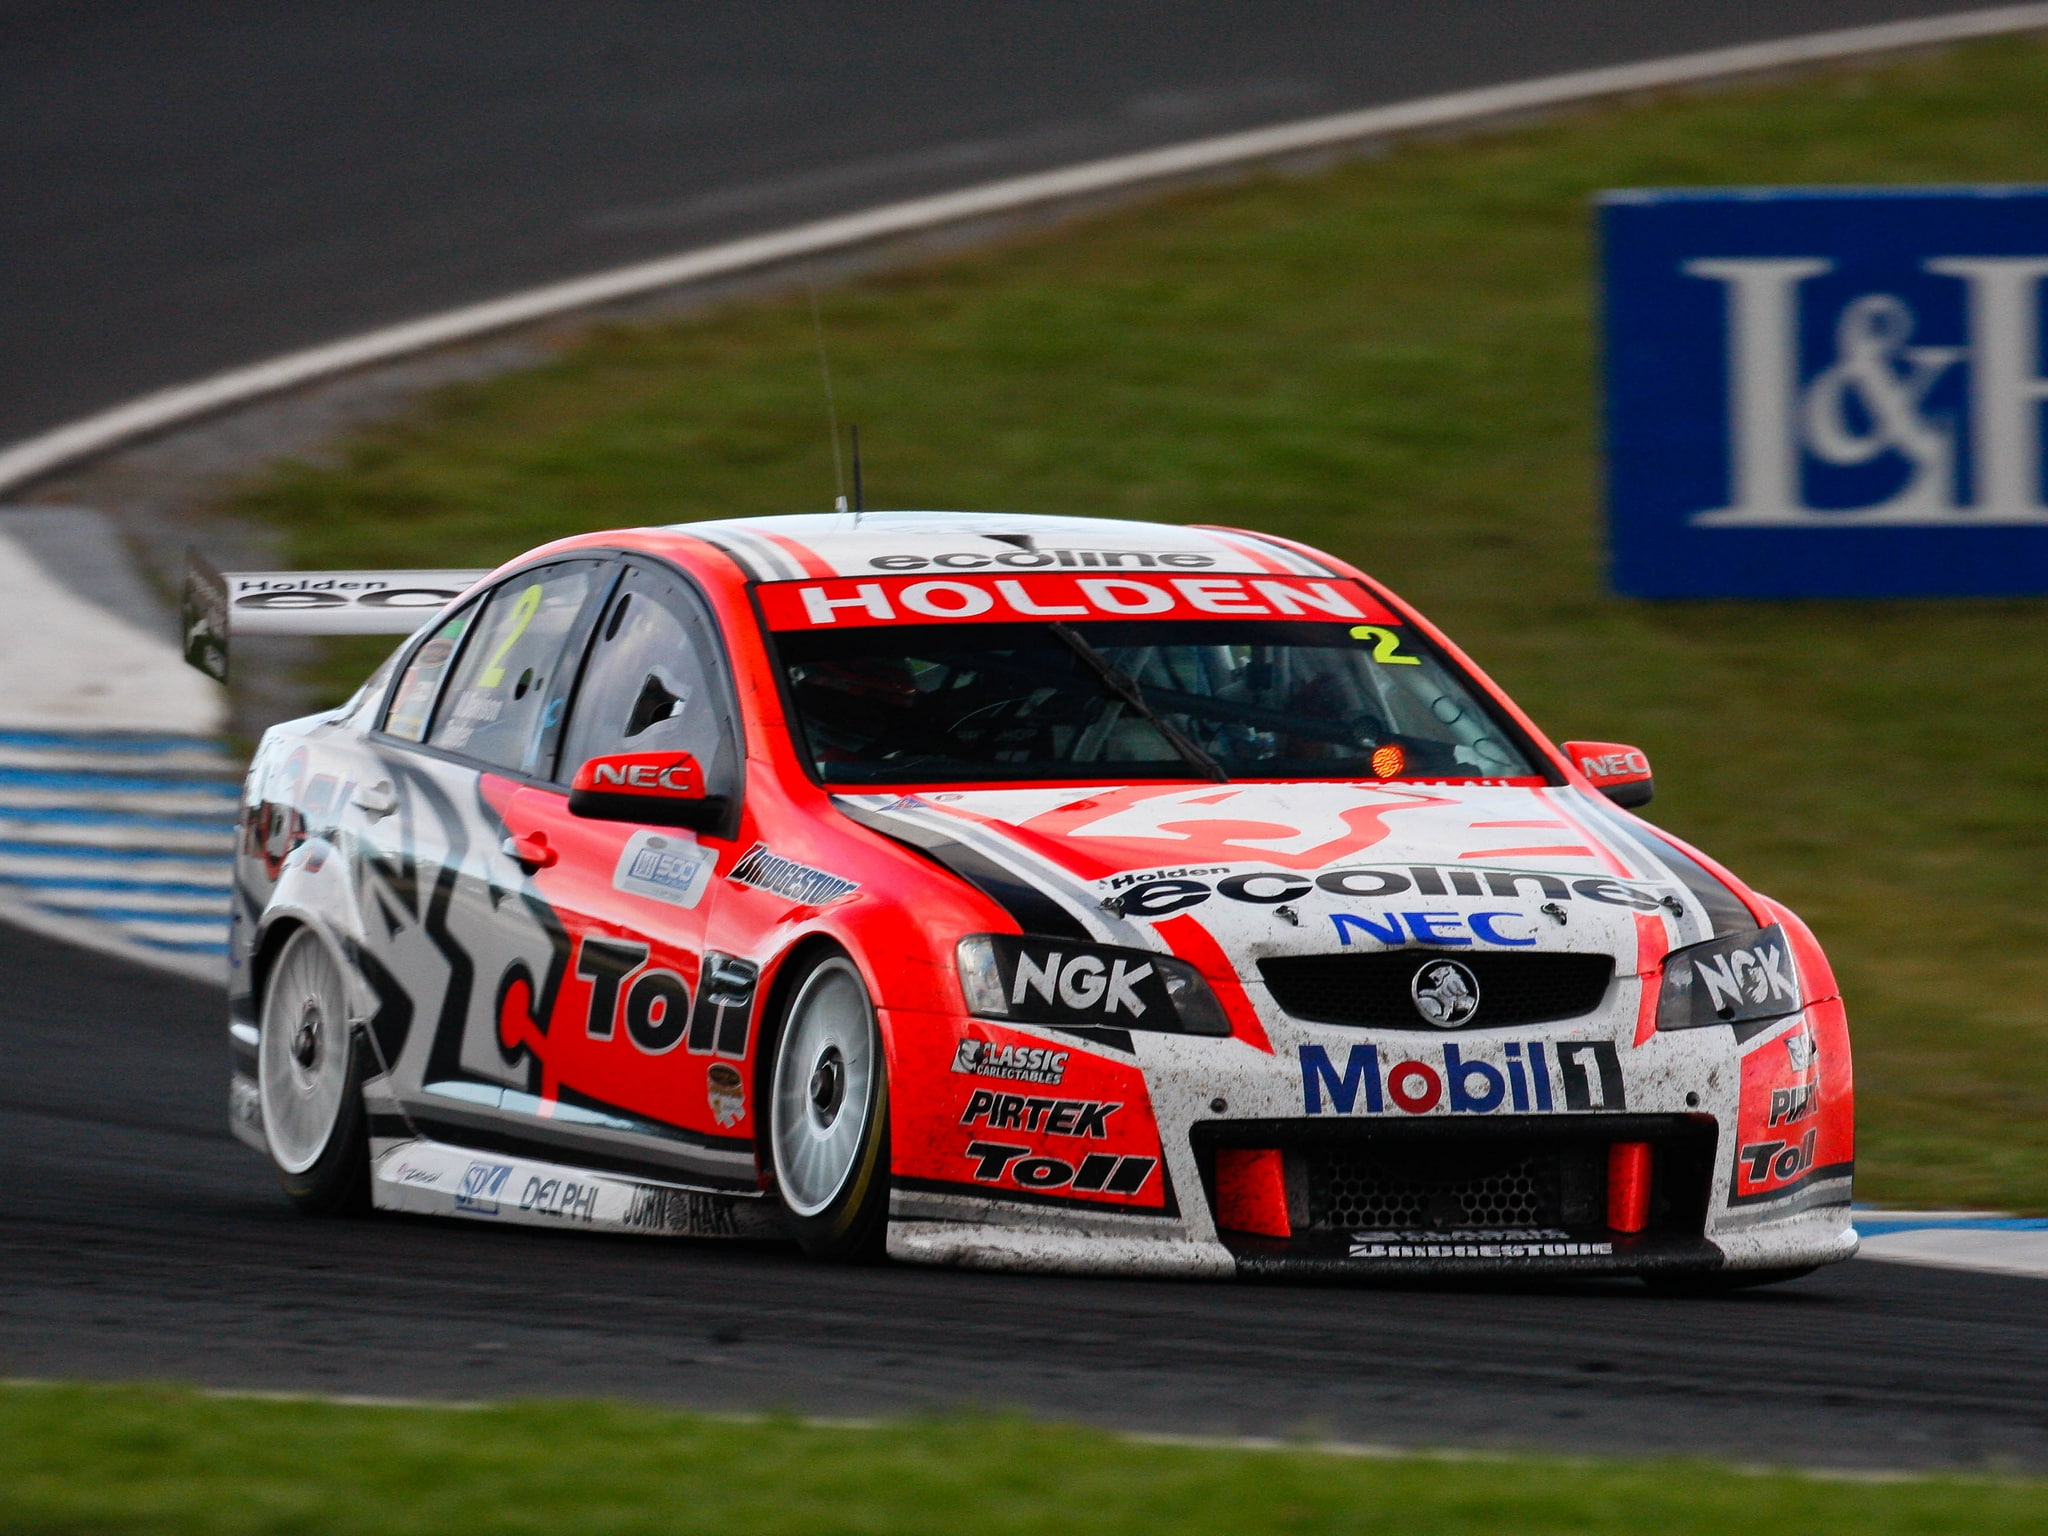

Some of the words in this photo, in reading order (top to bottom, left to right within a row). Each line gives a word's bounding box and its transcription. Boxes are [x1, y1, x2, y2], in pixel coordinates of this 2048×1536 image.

[869, 548, 1216, 572] ecoline
[240, 580, 388, 591] Holden
[800, 577, 1366, 624] HOLDEN
[477, 583, 543, 688] 2
[1349, 625, 1421, 666] 2
[593, 763, 692, 790] NEC
[1581, 750, 1649, 778] NEC
[1112, 866, 1230, 890] Holden
[1121, 867, 1660, 916] ecoline
[1328, 910, 1536, 946] NEC
[575, 935, 761, 1061] Toll
[1011, 950, 1154, 1019] NGK
[1694, 943, 1794, 1013] NGK
[976, 1065, 1062, 1086] CARLECTABLES
[982, 1041, 1070, 1074] CLASSIC
[1300, 1041, 1554, 1114] Mobil
[959, 1087, 1124, 1140] PIRTEK
[965, 1140, 1158, 1195] Toll
[1740, 1127, 1817, 1184] Toll
[518, 1176, 600, 1223] DELPHI
